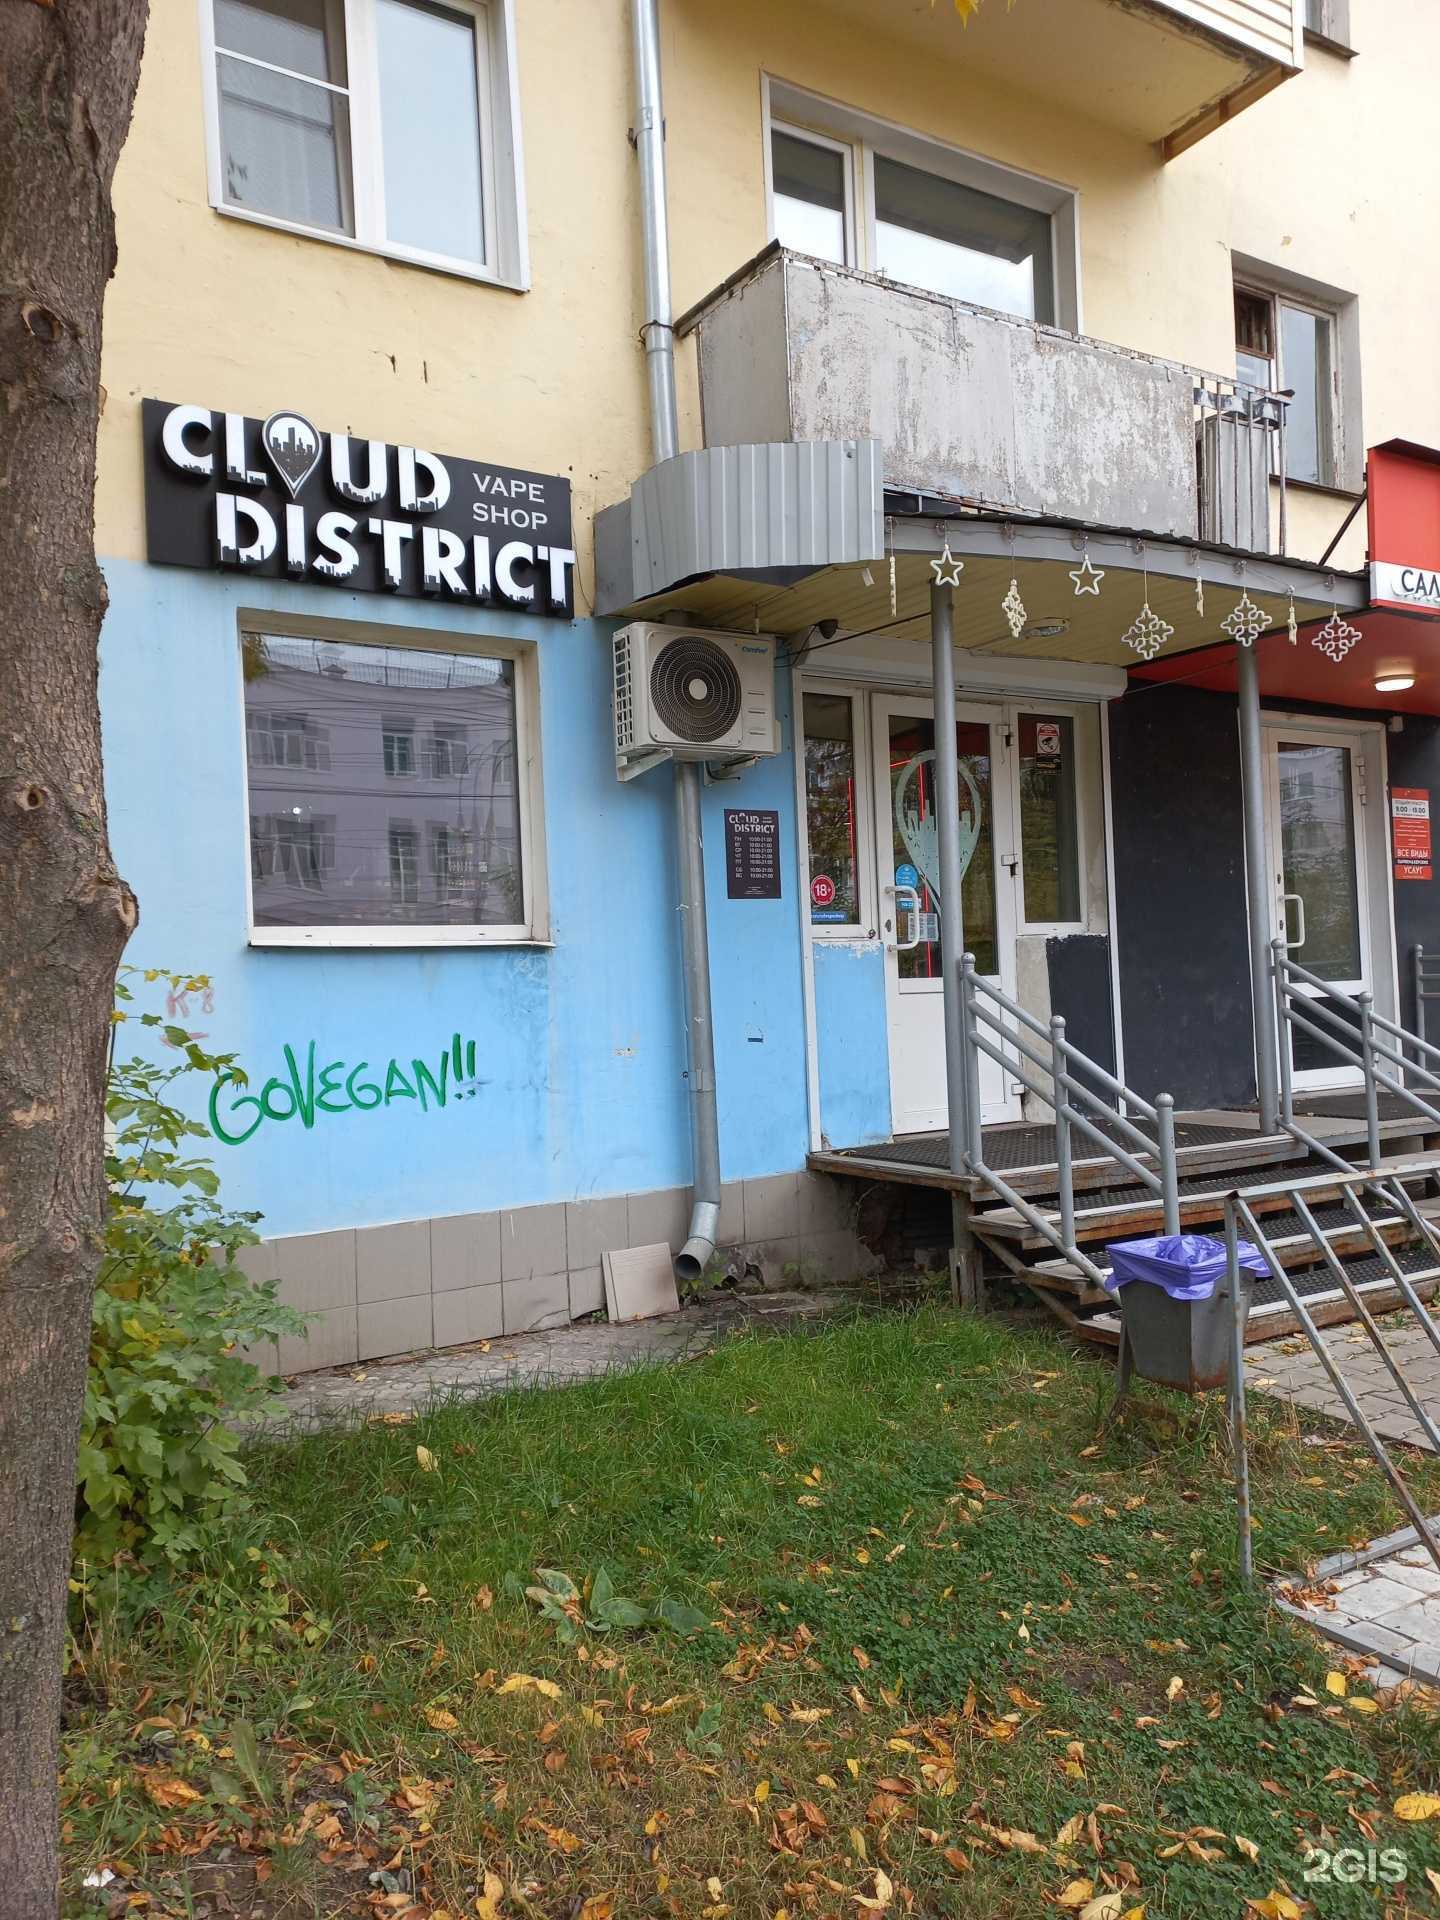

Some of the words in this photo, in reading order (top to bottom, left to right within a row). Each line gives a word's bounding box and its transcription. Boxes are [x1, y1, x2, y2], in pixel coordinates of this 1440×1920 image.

[472, 472, 545, 504] VAPE
[472, 502, 548, 531] SHOP
[215, 491, 577, 609] DISTRICT
[734, 823, 775, 834] DISTRICT
[814, 884, 832, 897] 18+
